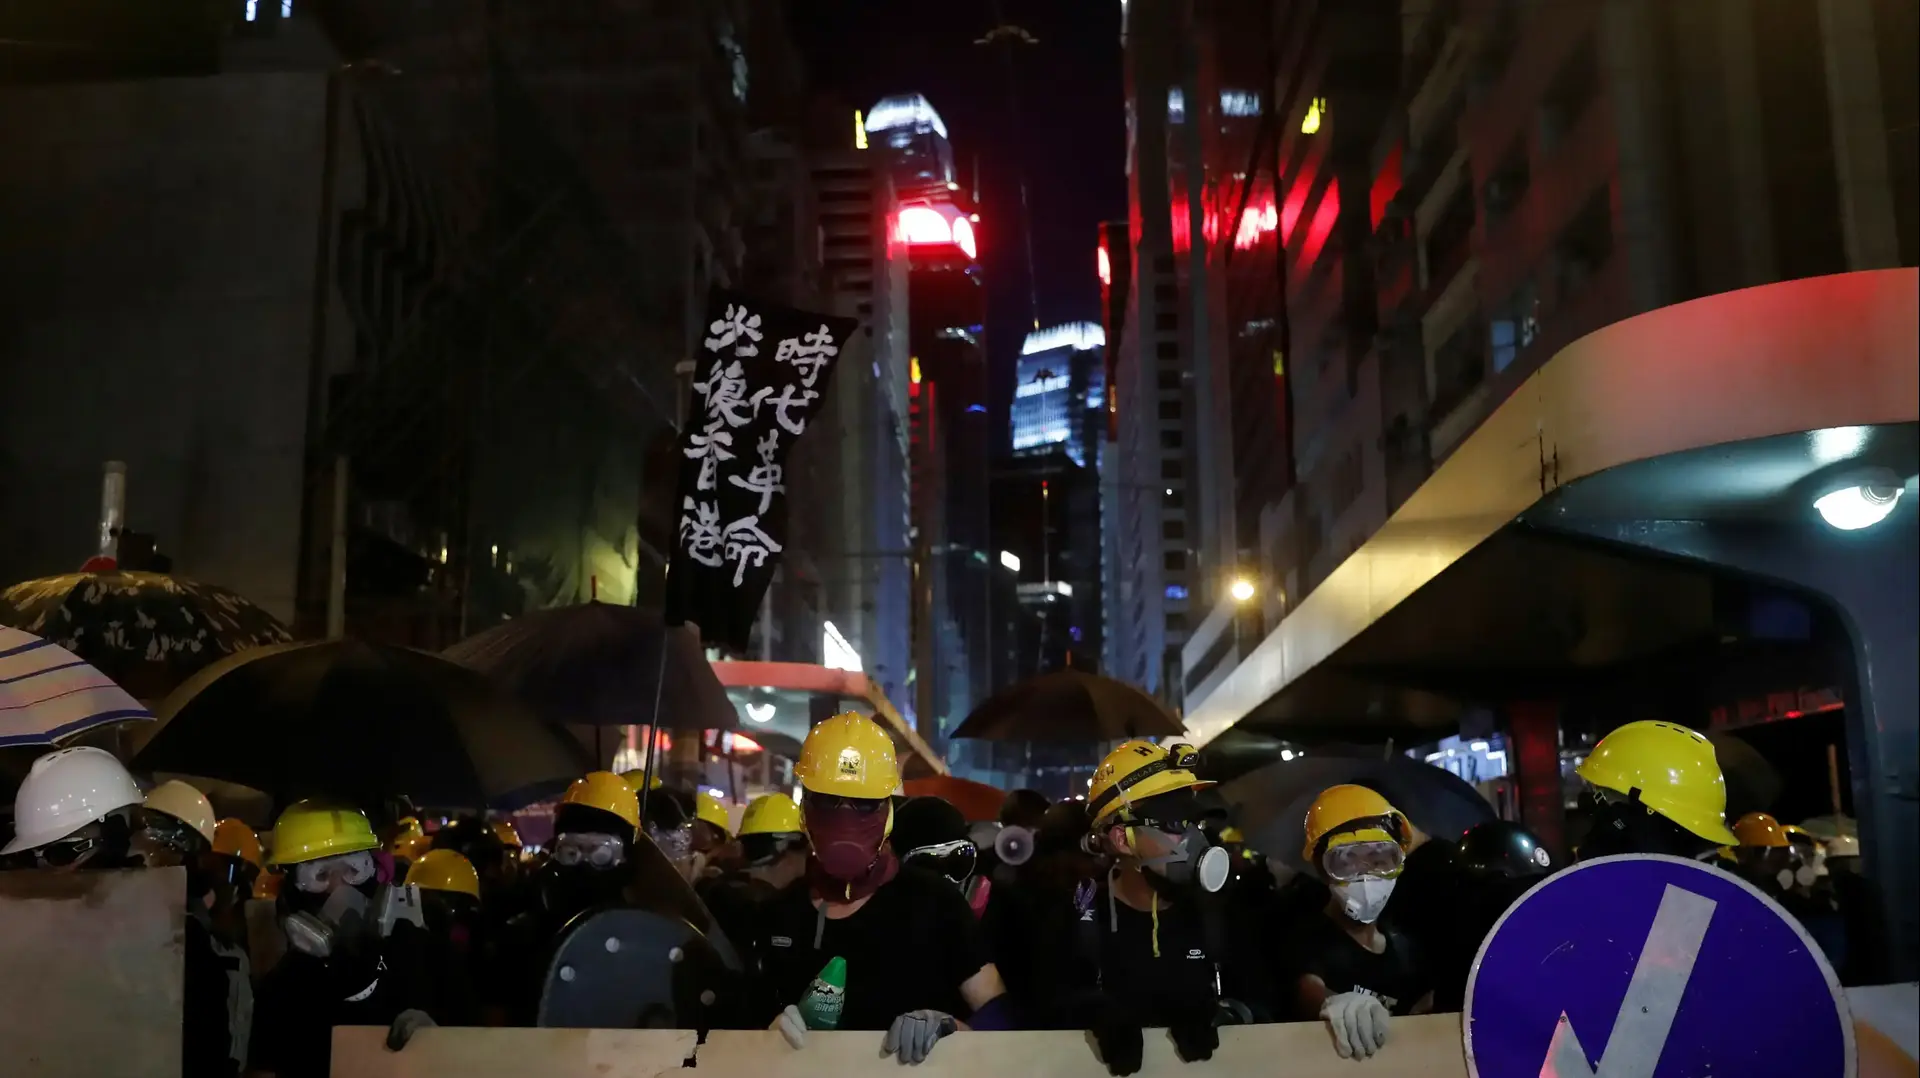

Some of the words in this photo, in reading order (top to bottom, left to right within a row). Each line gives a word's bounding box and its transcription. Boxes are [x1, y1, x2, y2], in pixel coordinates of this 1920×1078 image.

[680, 303, 764, 569] 光復香港
[722, 324, 838, 588] 時代革命
[1133, 746, 1153, 757] H
